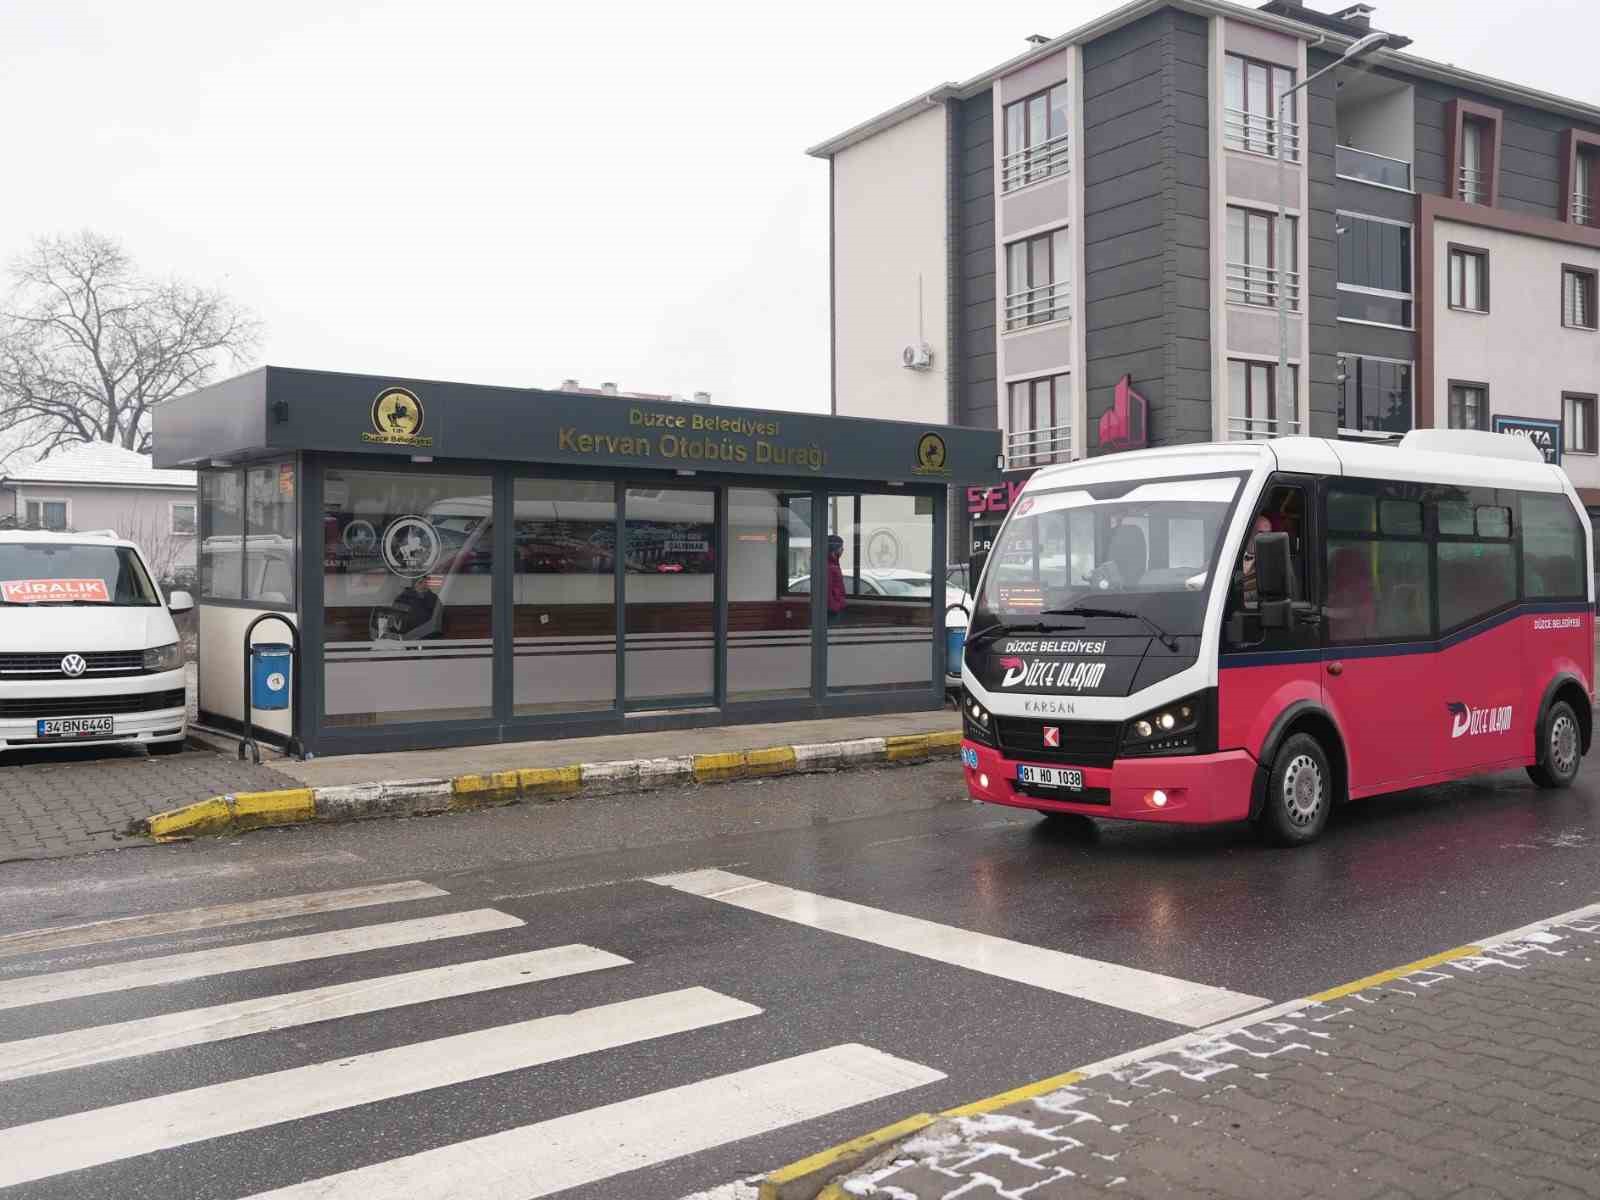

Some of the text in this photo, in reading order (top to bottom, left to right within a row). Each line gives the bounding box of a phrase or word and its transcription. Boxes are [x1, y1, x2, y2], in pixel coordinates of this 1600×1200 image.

[629, 407, 780, 438] Düzce Belediyesi
[559, 426, 829, 471] Kervan Otobüs Durağı
[1006, 639, 1106, 654] DÜZCE BELEDİYESİ
[1056, 661, 1106, 691] ULAŞIM
[1024, 700, 1076, 714] KARSAN
[1057, 770, 1082, 786] 1038
